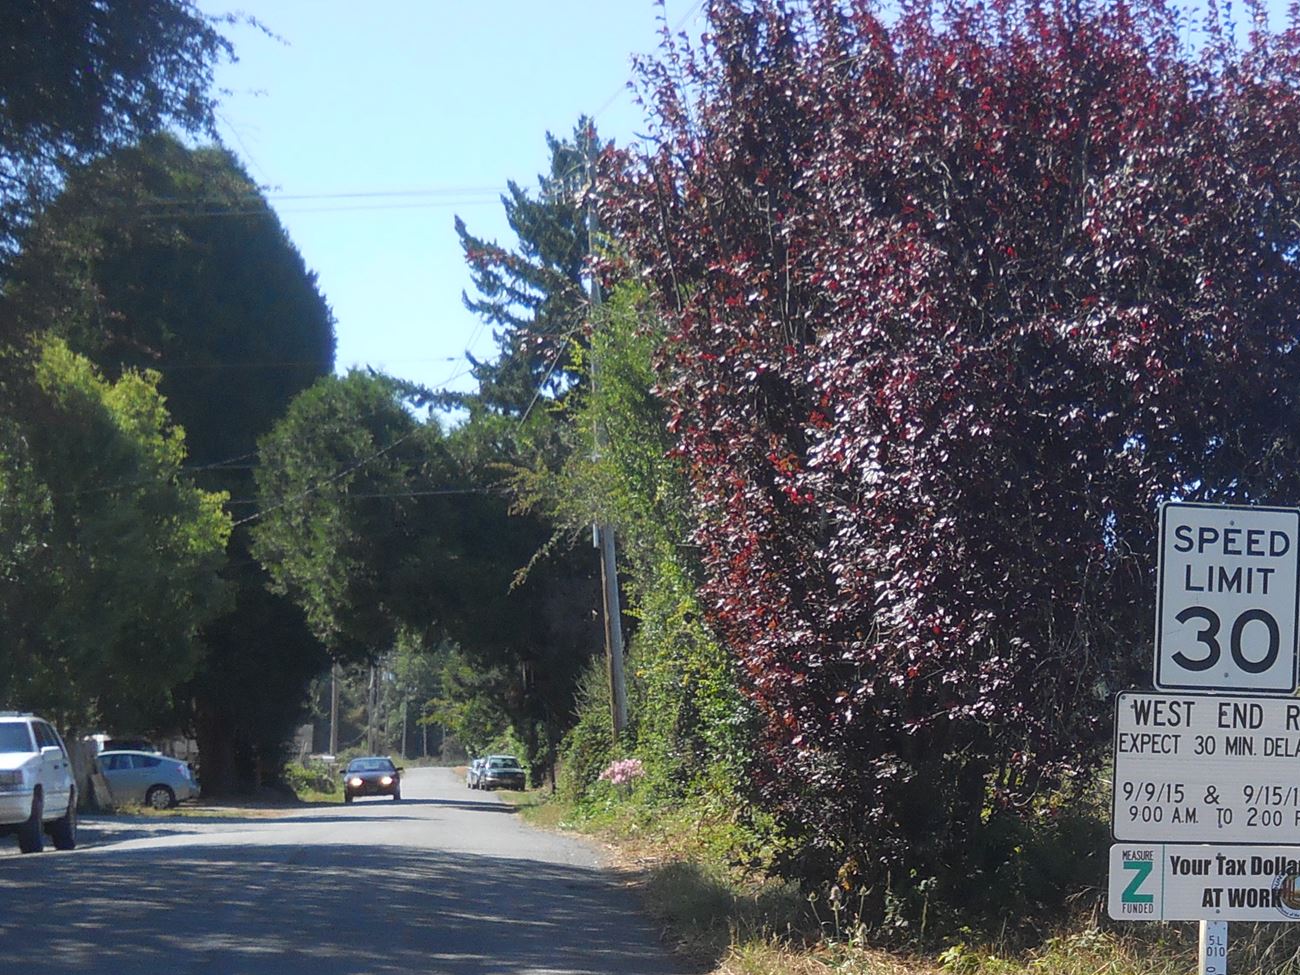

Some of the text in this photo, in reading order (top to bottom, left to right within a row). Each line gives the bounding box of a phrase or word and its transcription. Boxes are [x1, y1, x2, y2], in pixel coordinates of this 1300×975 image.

[1174, 525, 1290, 557] SPEED
[1185, 564, 1275, 594] LIMIT
[1171, 606, 1280, 674] 30
[1133, 699, 1195, 727] WEST
[1218, 702, 1263, 729] END
[1119, 733, 1181, 754] EXPECT
[1194, 735, 1216, 755] 30
[1225, 736, 1257, 756] MIN.
[1123, 782, 1185, 804] 9/9/15
[1204, 785, 1220, 805] &
[1172, 808, 1199, 824] A.M.
[1216, 808, 1233, 825] TO
[1122, 850, 1154, 860] MEASURE
[1170, 856, 1211, 875] Your
[1216, 856, 1246, 875] Tax
[1122, 861, 1154, 902] Z
[1122, 903, 1154, 914] FUNDED
[1202, 888, 1284, 908] AT WORK
